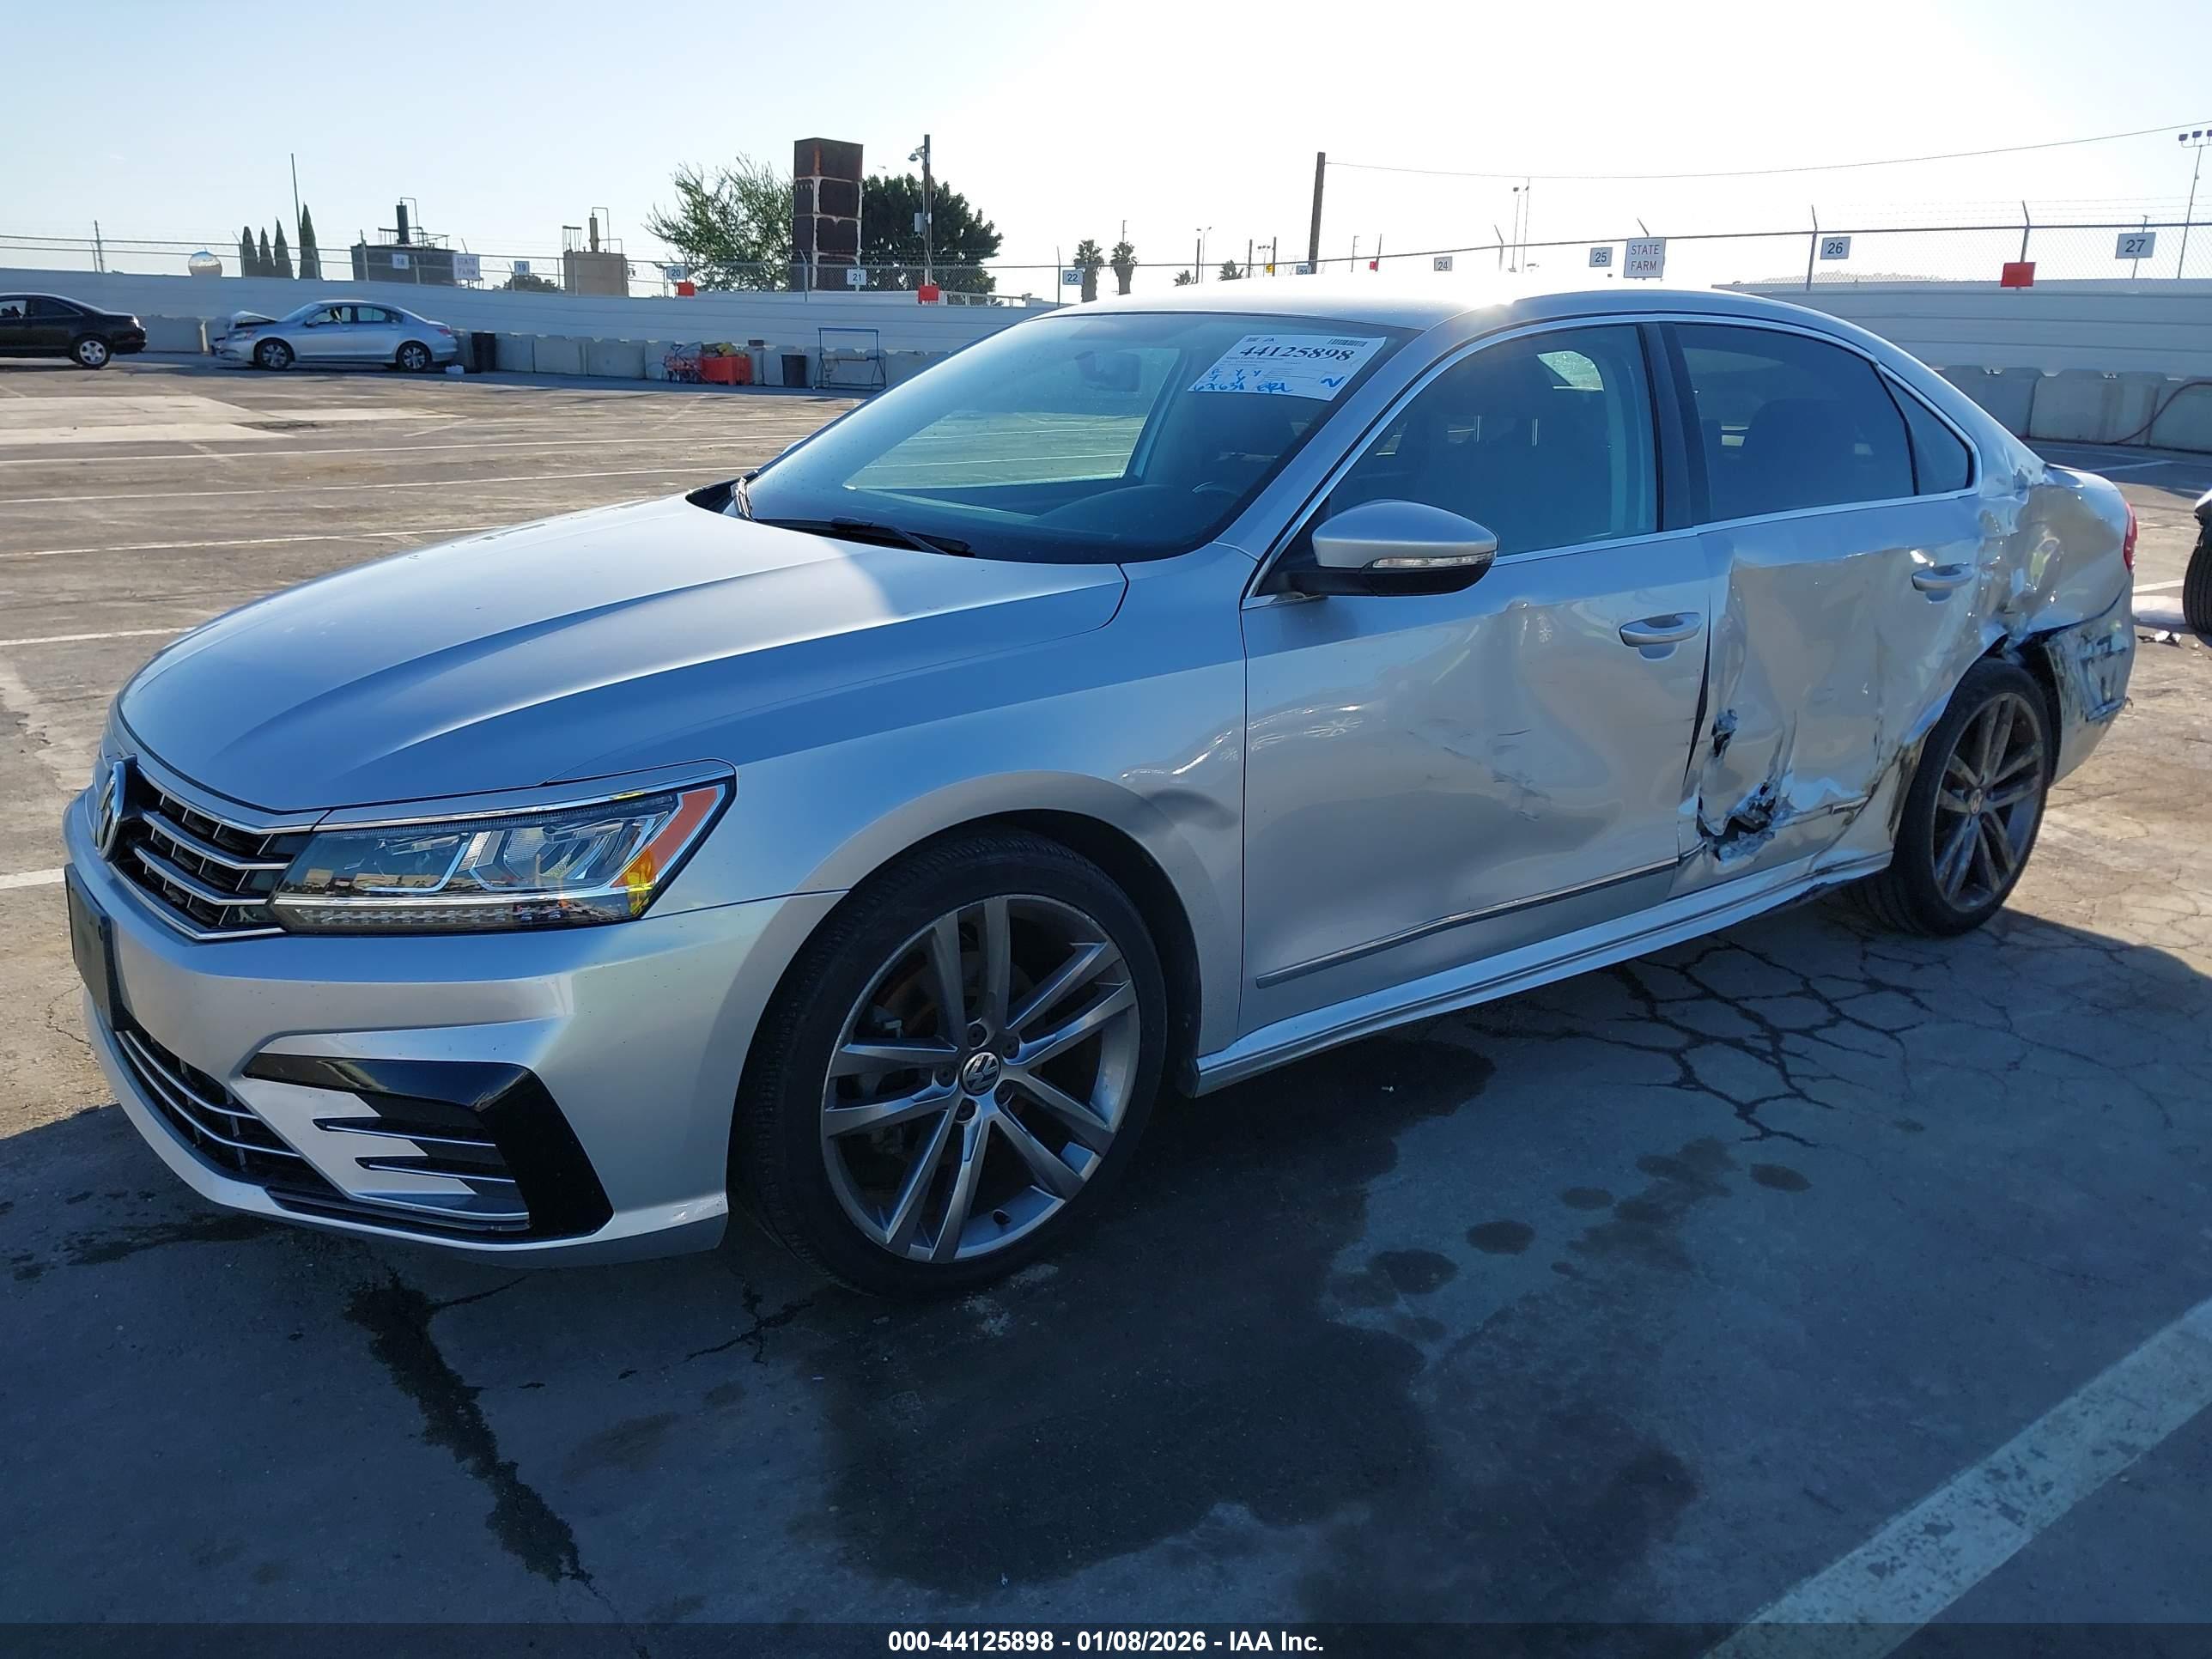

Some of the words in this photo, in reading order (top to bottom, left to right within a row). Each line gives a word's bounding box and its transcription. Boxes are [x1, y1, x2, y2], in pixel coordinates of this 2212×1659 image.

[1631, 244, 1660, 255] STATE
[1827, 242, 1843, 254] 26
[2125, 239, 2146, 253] 27
[1595, 252, 1607, 263] 25
[1438, 261, 1449, 270] 24
[1631, 260, 1656, 271] FARM
[672, 269, 681, 277] 20
[853, 273, 862, 282] 21
[1067, 273, 1079, 282] 22
[1239, 345, 1355, 362] 44125898
